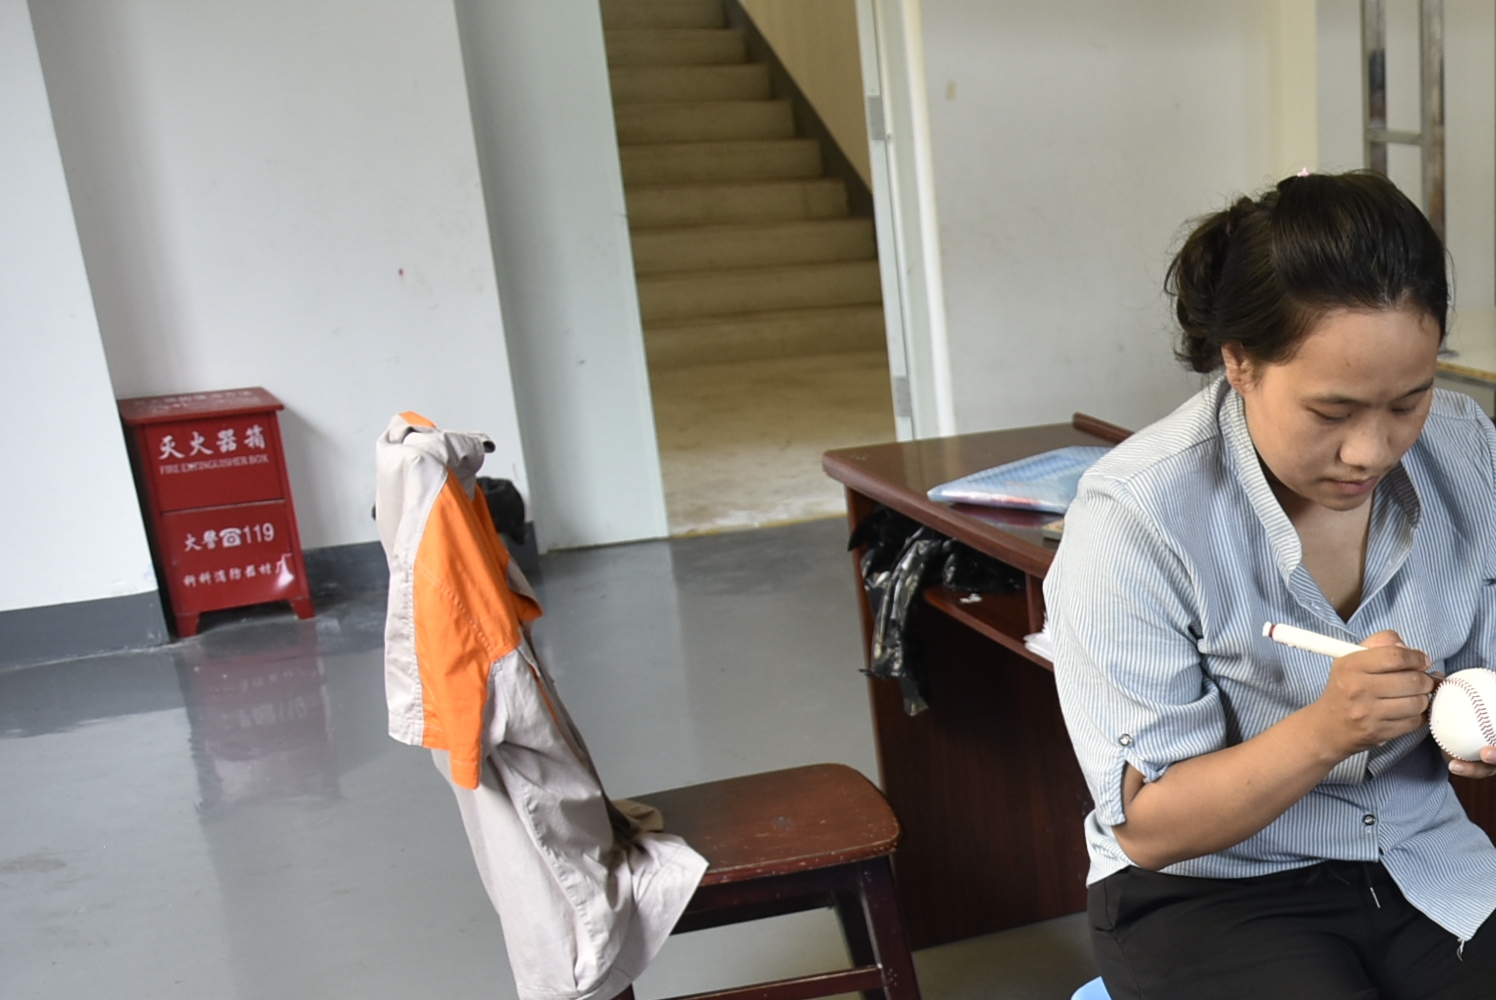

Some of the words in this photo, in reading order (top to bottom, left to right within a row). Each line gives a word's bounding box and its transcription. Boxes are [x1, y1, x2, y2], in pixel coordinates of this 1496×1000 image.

[158, 424, 267, 460] 灭火器箱
[243, 522, 275, 544] 119
